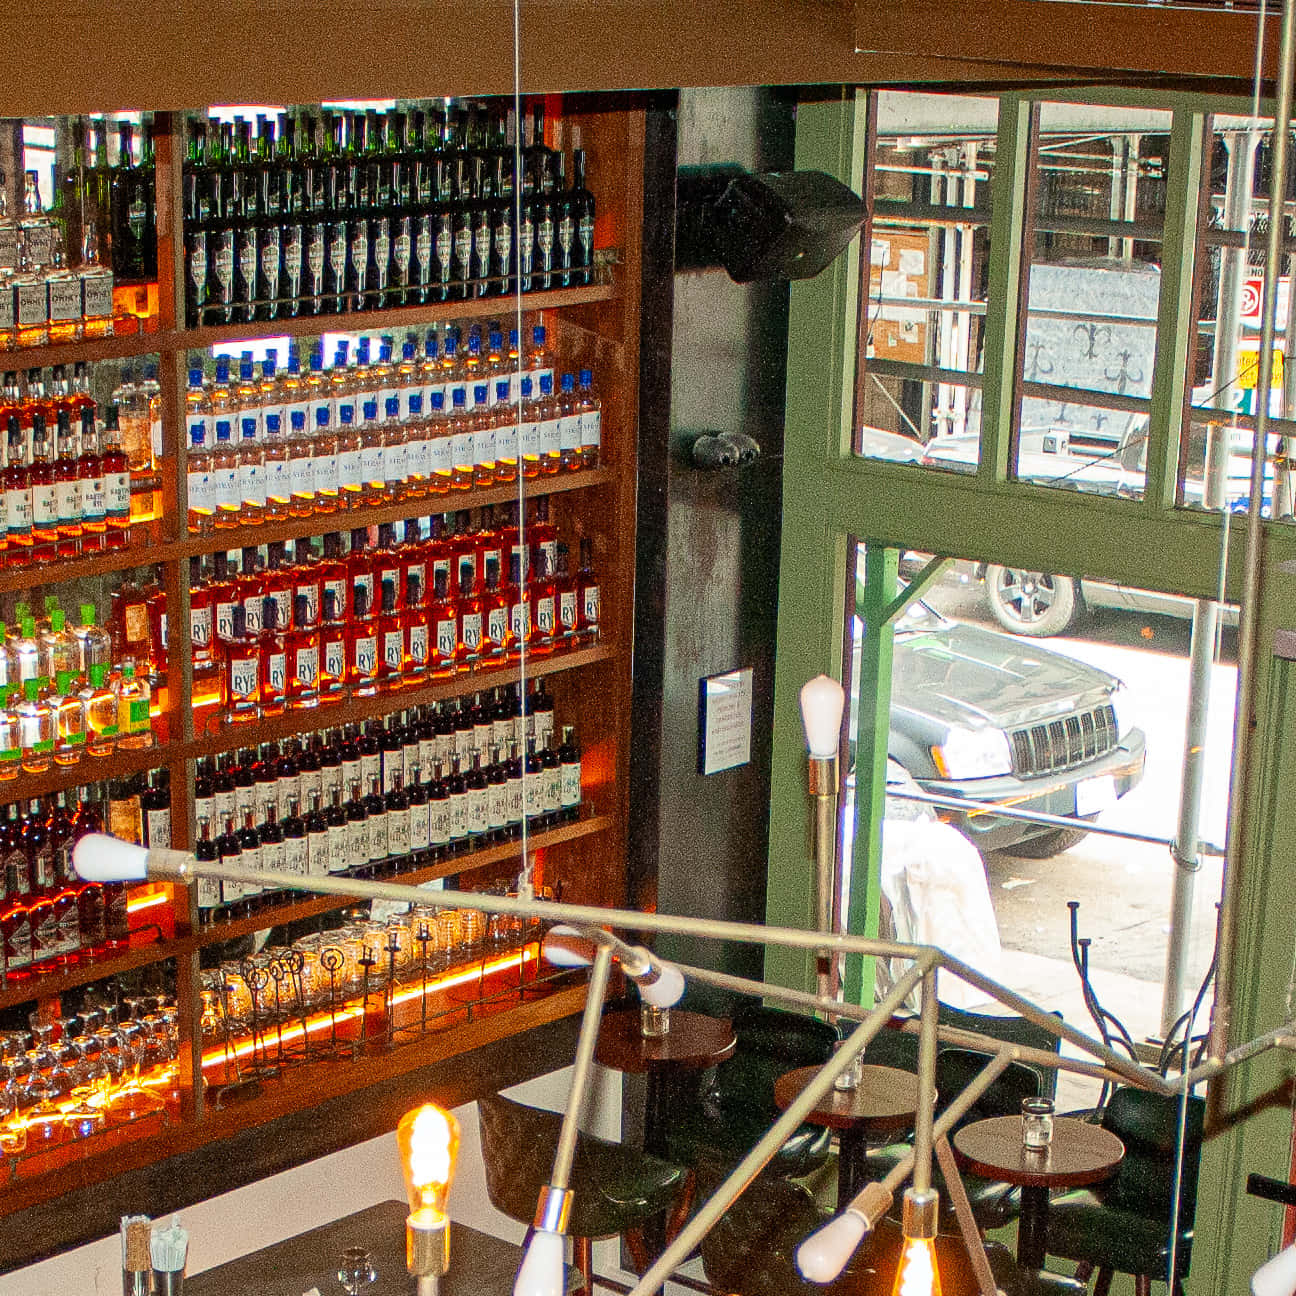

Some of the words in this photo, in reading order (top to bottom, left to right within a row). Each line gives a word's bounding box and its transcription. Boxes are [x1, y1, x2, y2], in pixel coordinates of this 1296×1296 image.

[562, 606, 576, 620] RY
[586, 601, 598, 615] RY
[219, 619, 232, 633] RY
[247, 613, 263, 628] RY
[539, 612, 553, 626] RY
[490, 622, 505, 636] RY
[412, 641, 426, 656] RY
[440, 635, 455, 649] RY
[387, 648, 401, 662] RY
[329, 657, 343, 672] RY
[234, 674, 255, 692] RYE
[272, 671, 285, 686] RY
